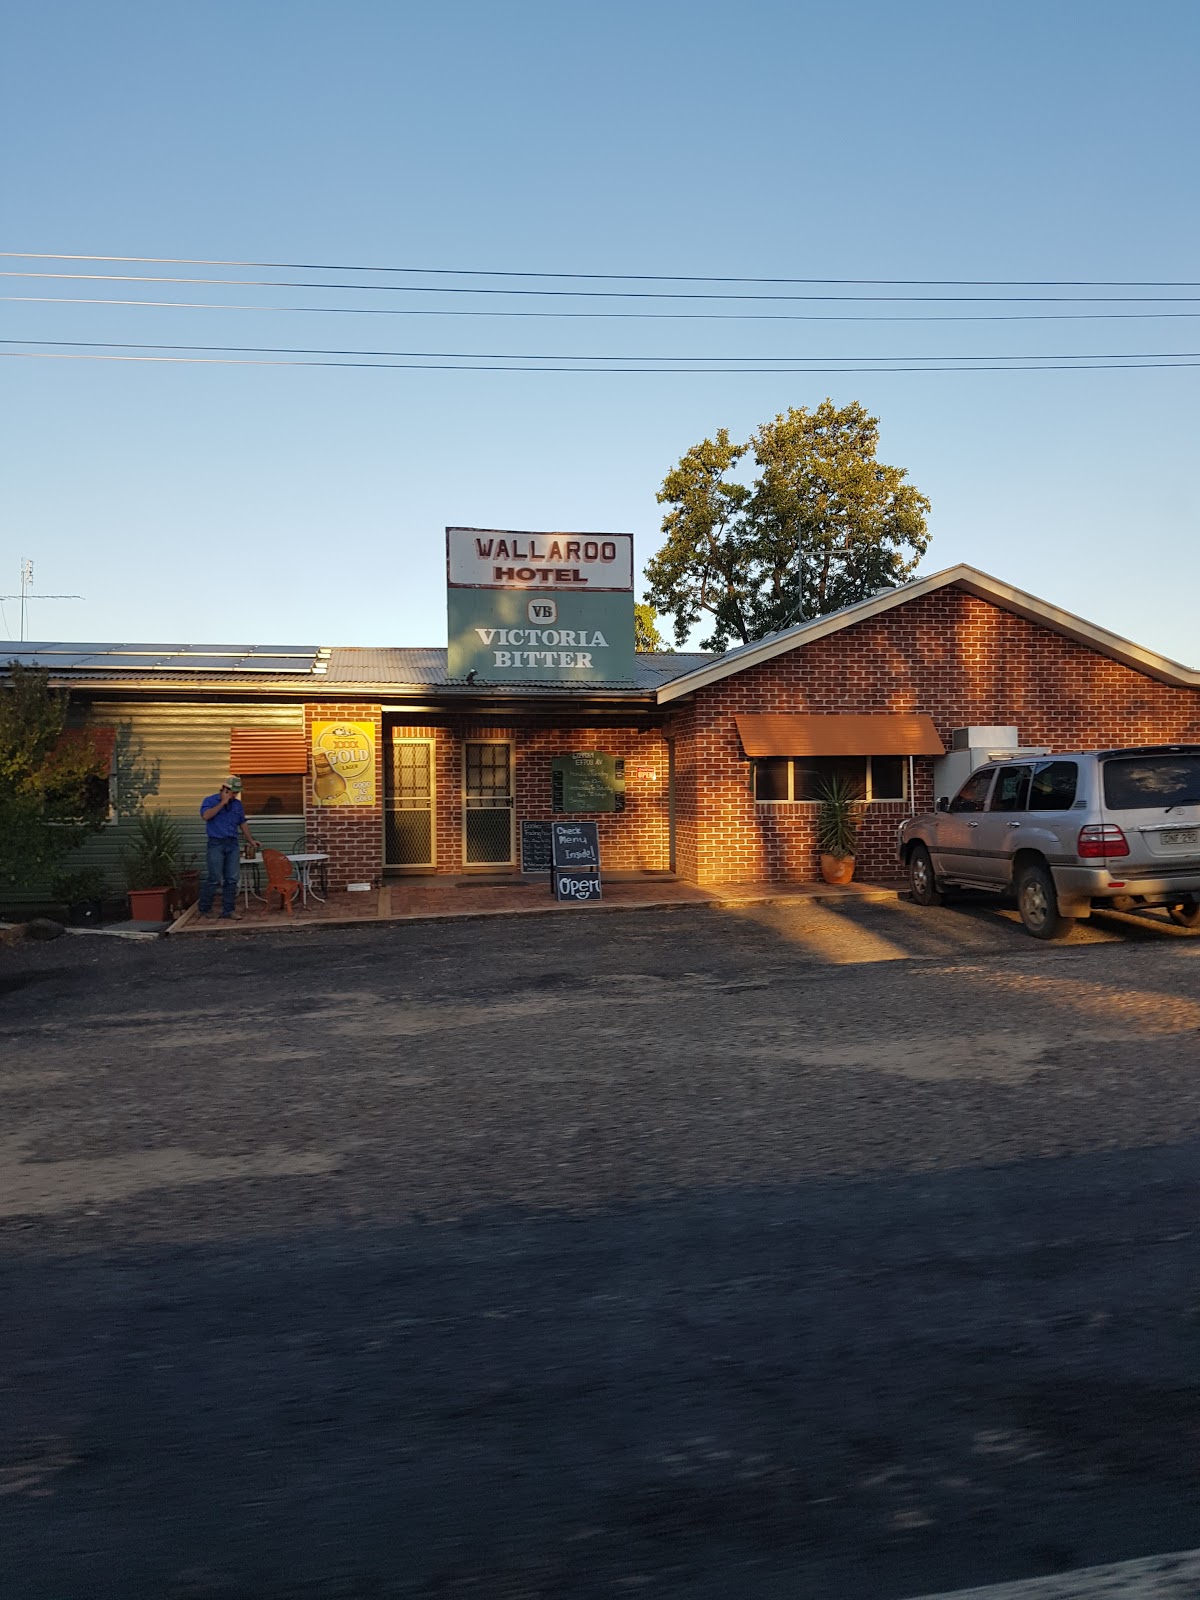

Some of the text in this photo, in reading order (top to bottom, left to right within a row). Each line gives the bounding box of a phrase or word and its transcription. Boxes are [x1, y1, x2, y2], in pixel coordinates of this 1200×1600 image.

[474, 538, 617, 563] WALLAROO
[492, 566, 588, 585] HOTEL
[532, 605, 553, 618] VB
[474, 628, 610, 647] VICTORIA
[493, 651, 594, 668] BITTER
[325, 750, 368, 765] GOLD
[556, 826, 582, 835] Check
[558, 836, 587, 844] Menu
[565, 846, 597, 861] Inside!
[559, 878, 601, 896] Open
